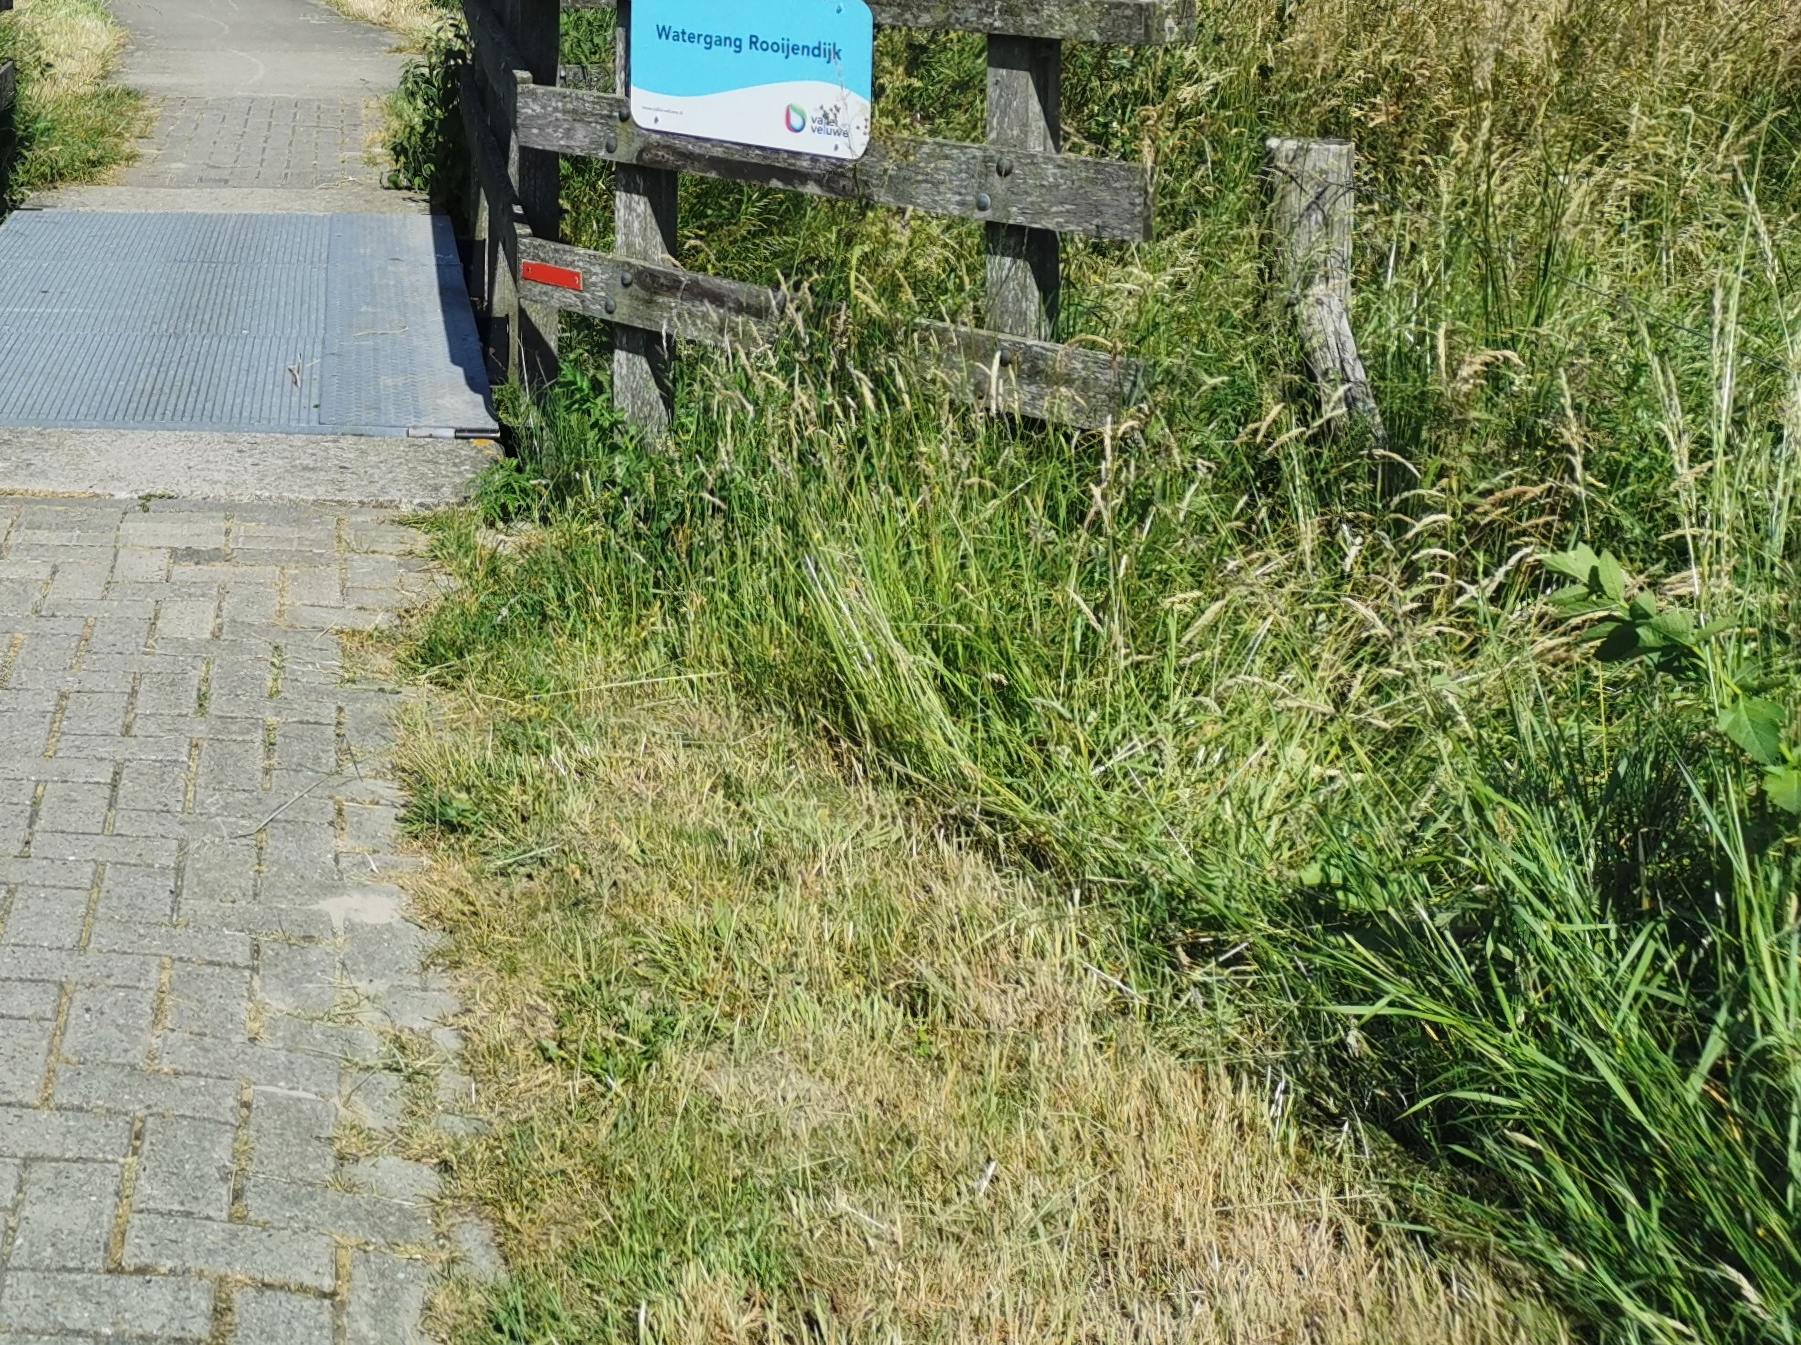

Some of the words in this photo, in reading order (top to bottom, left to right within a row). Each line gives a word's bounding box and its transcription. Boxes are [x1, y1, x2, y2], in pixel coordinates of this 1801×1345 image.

[656, 24, 743, 53] Watergang
[749, 34, 842, 64] Rooijendijk
[811, 125, 849, 138] veluwe
